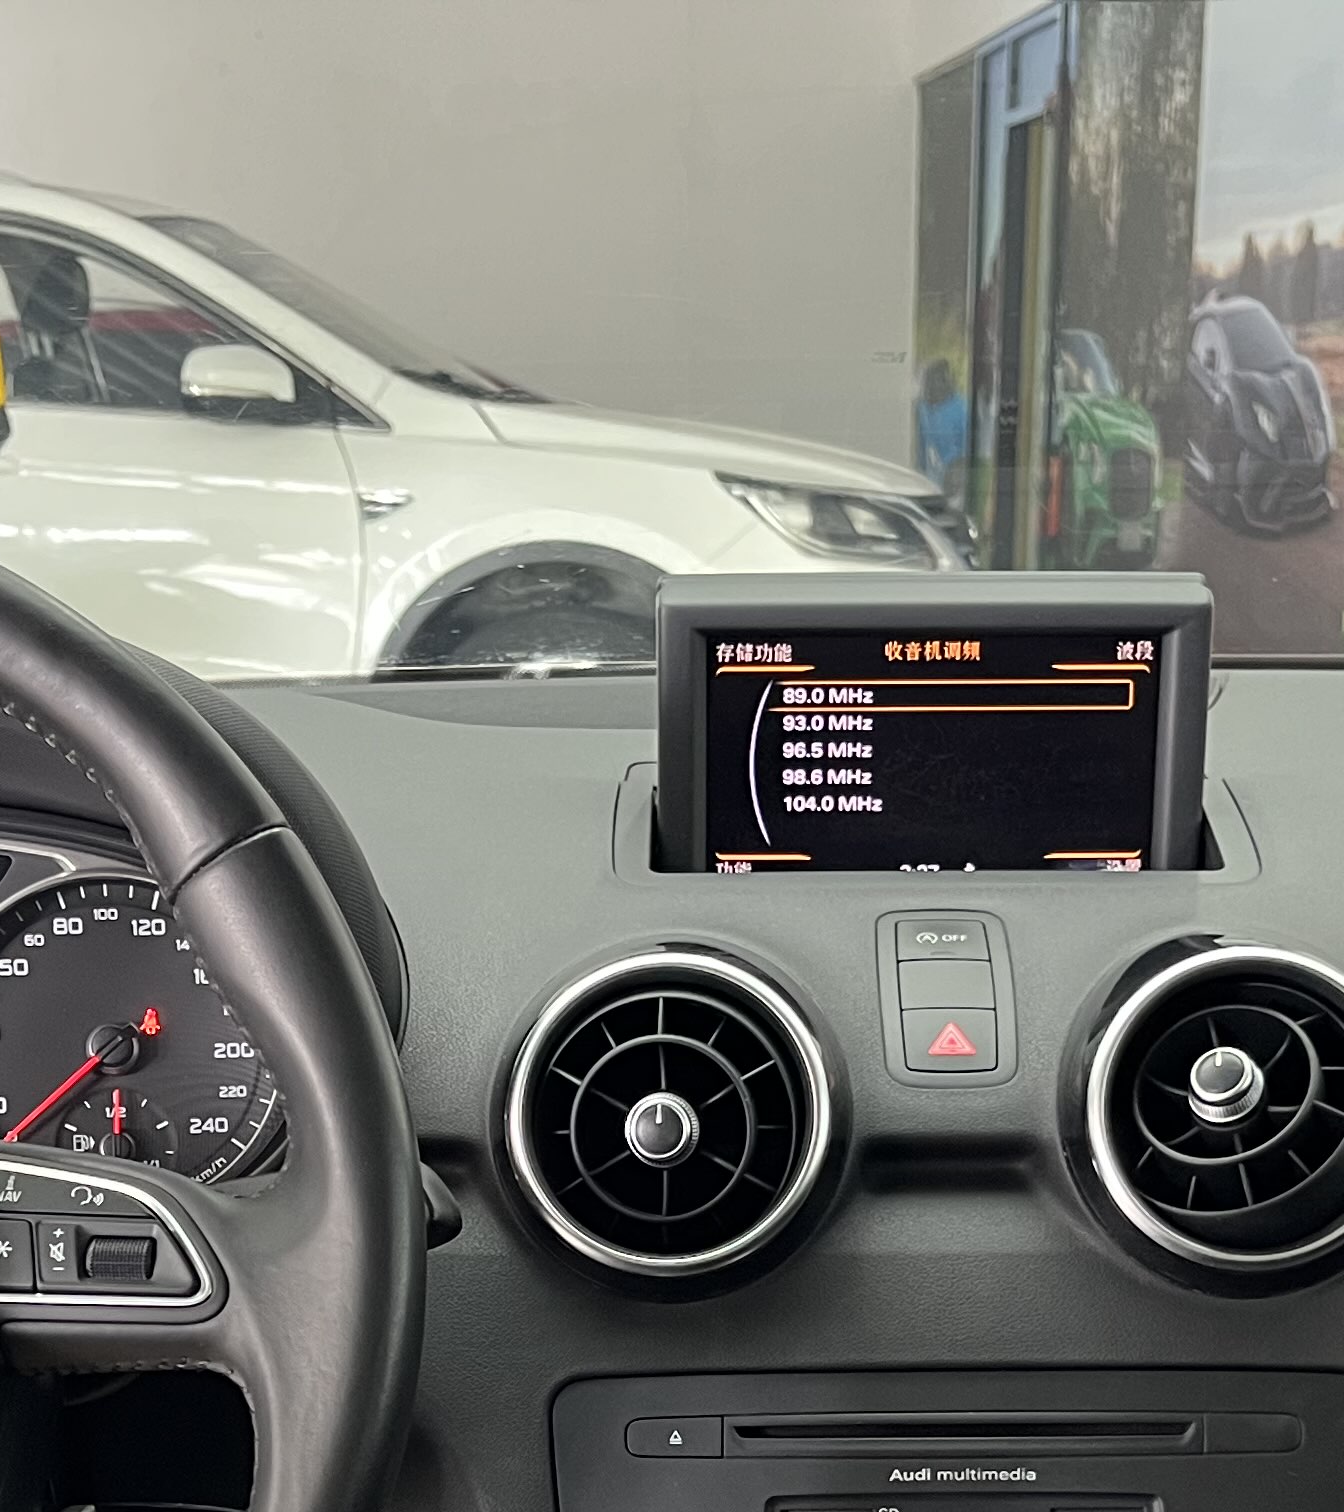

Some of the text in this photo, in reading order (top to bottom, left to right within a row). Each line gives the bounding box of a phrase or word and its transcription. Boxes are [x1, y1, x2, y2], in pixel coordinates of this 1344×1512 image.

[715, 642, 793, 663] 存储功能
[884, 640, 981, 662] 收音机调频
[1116, 640, 1154, 661] 波段
[782, 687, 875, 705] 89.0 MHz
[782, 714, 874, 732] 93.0 MHz
[782, 741, 873, 759] 96.5 MHz
[782, 768, 873, 786] 98.6 MHz
[783, 794, 883, 813] 104.0 MHz
[92, 908, 119, 921] 100
[52, 917, 84, 935] 80
[131, 918, 166, 936] 120
[23, 934, 45, 947] 60
[941, 934, 967, 942] OFF
[213, 1041, 255, 1059] 200
[218, 1084, 248, 1098] 220
[189, 1117, 229, 1134] 240
[889, 1467, 1037, 1482] Audi multimedia
